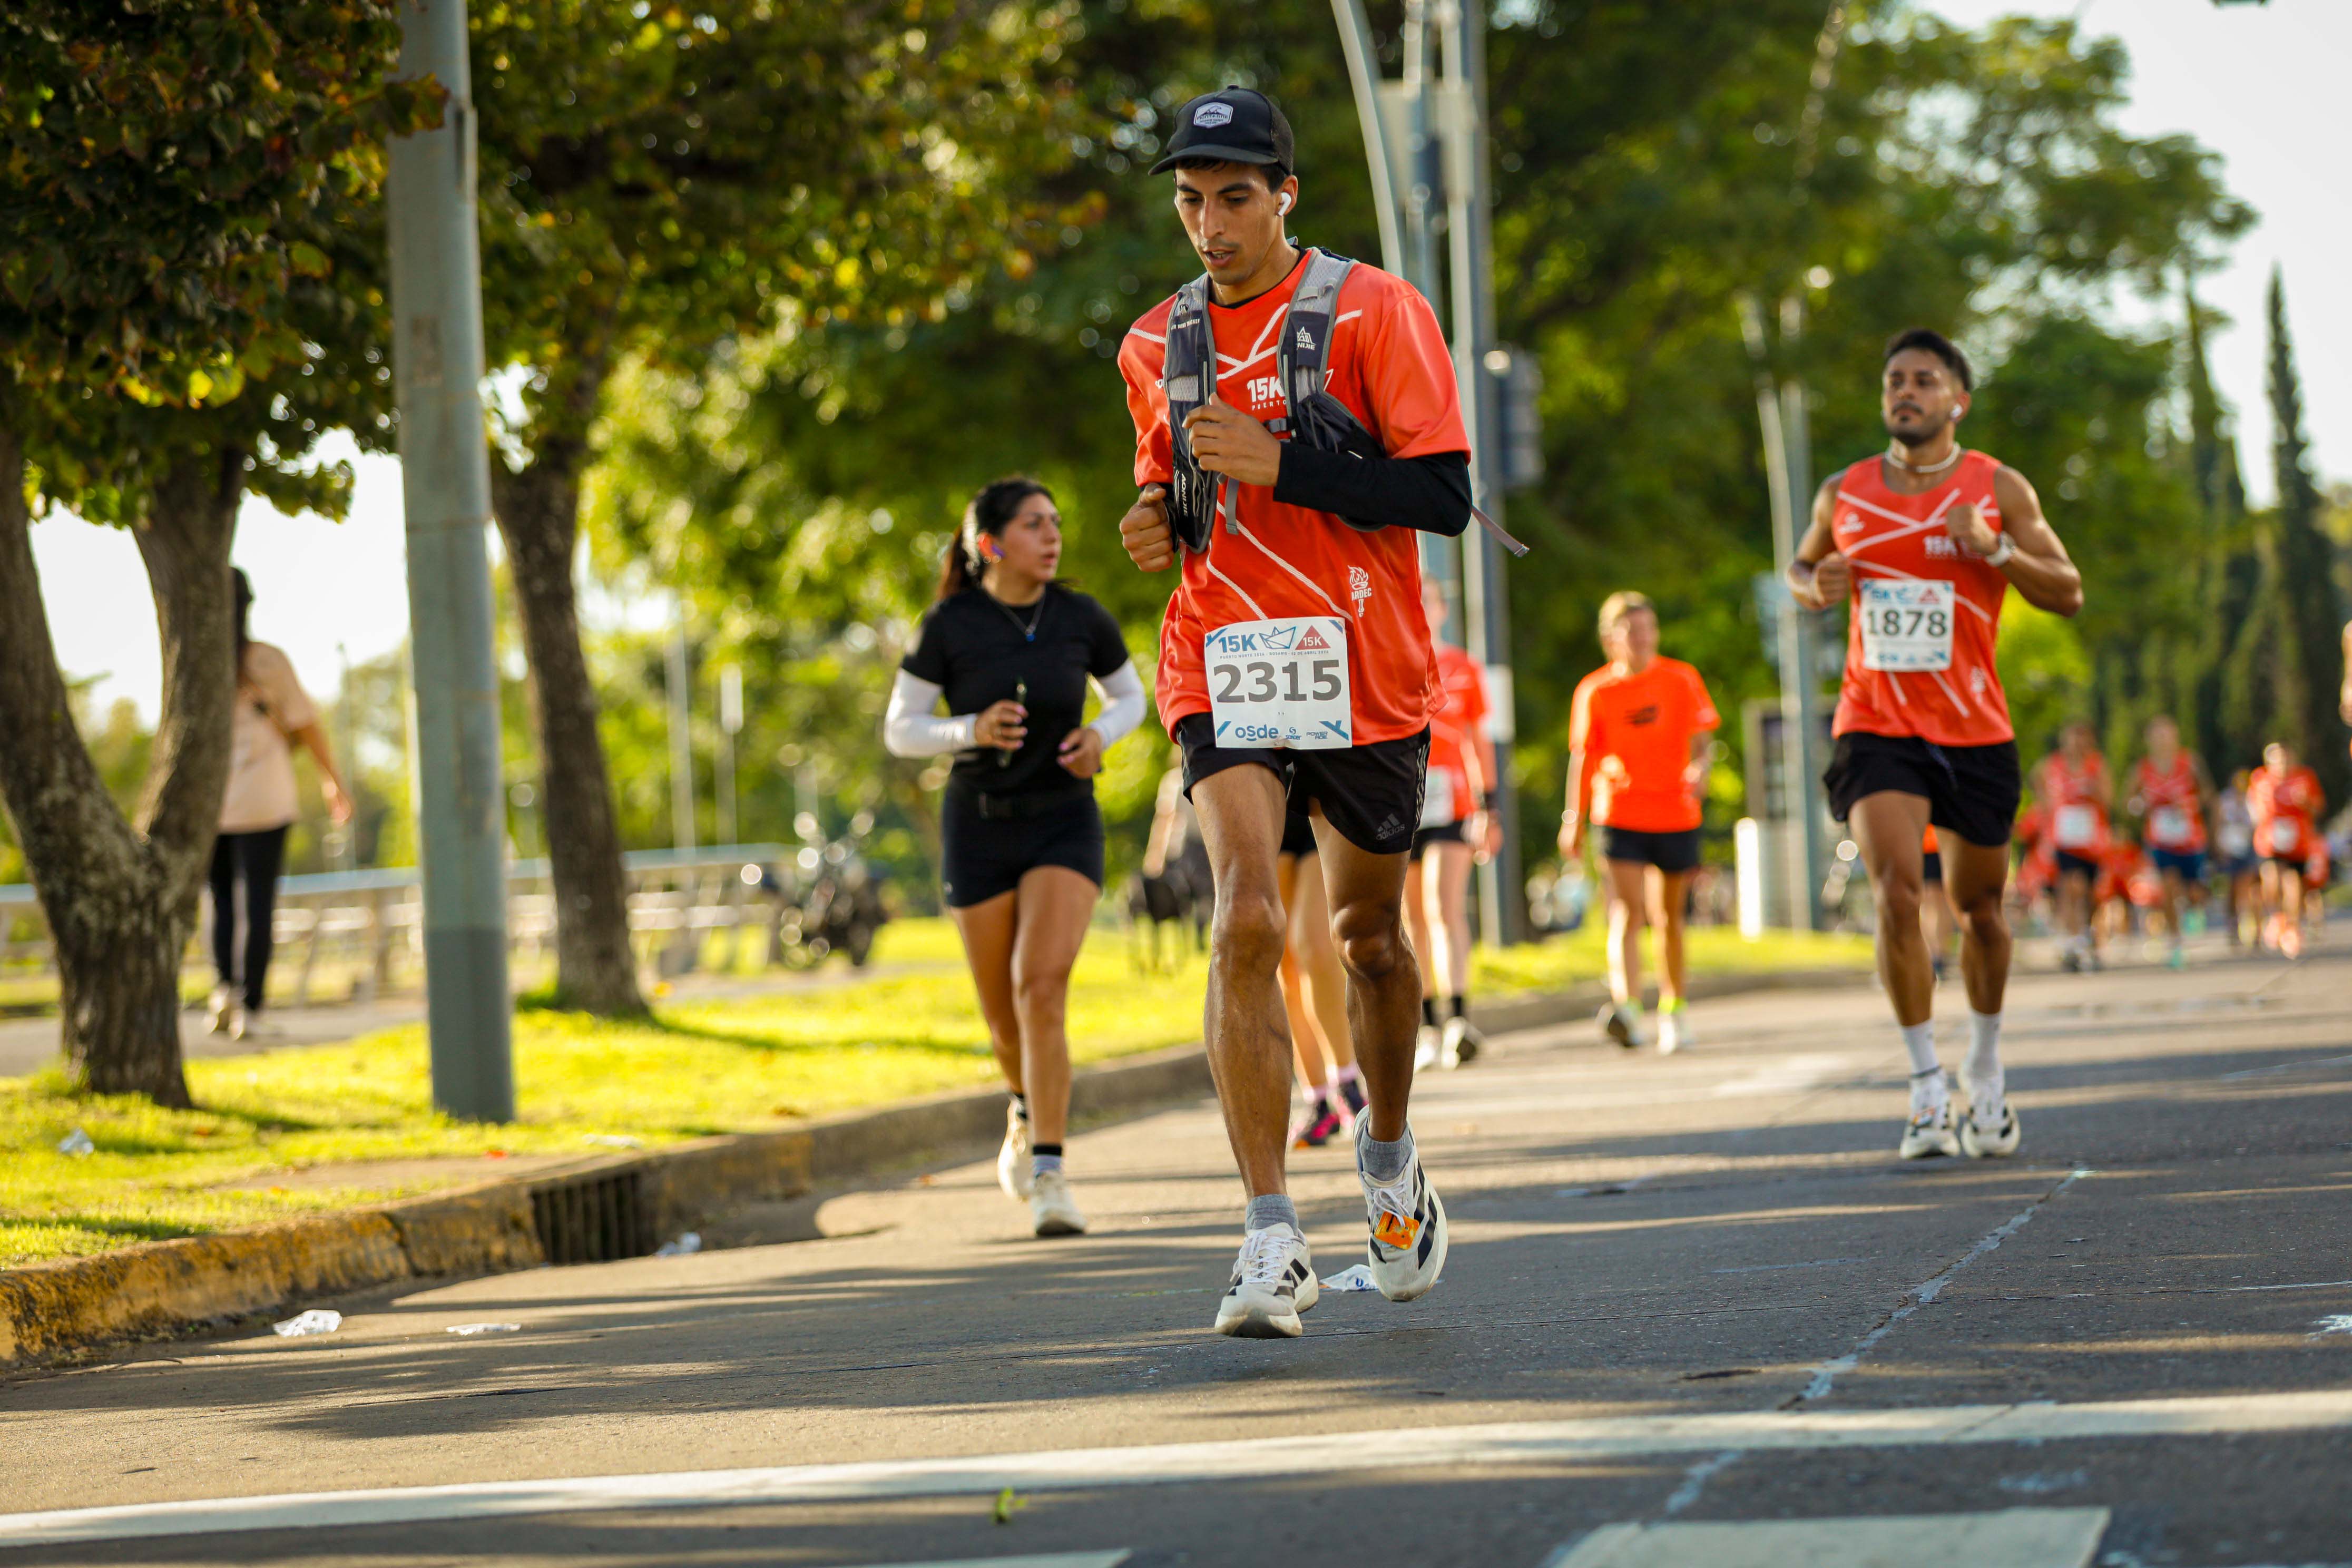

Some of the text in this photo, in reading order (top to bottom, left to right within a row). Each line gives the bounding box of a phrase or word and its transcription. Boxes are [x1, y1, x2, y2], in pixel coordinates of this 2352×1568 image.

[1297, 342, 1316, 351] NIJIE
[1247, 376, 1286, 403] 15K
[1251, 400, 1287, 411] PUERTO
[1351, 587, 1373, 601] ARDEC
[1867, 609, 1947, 637] 1878
[1218, 634, 1258, 653] 15K
[1302, 636, 1322, 647] 15K
[1213, 659, 1342, 703] 2315
[1234, 724, 1279, 741] osde
[1376, 824, 1405, 840] adidas
